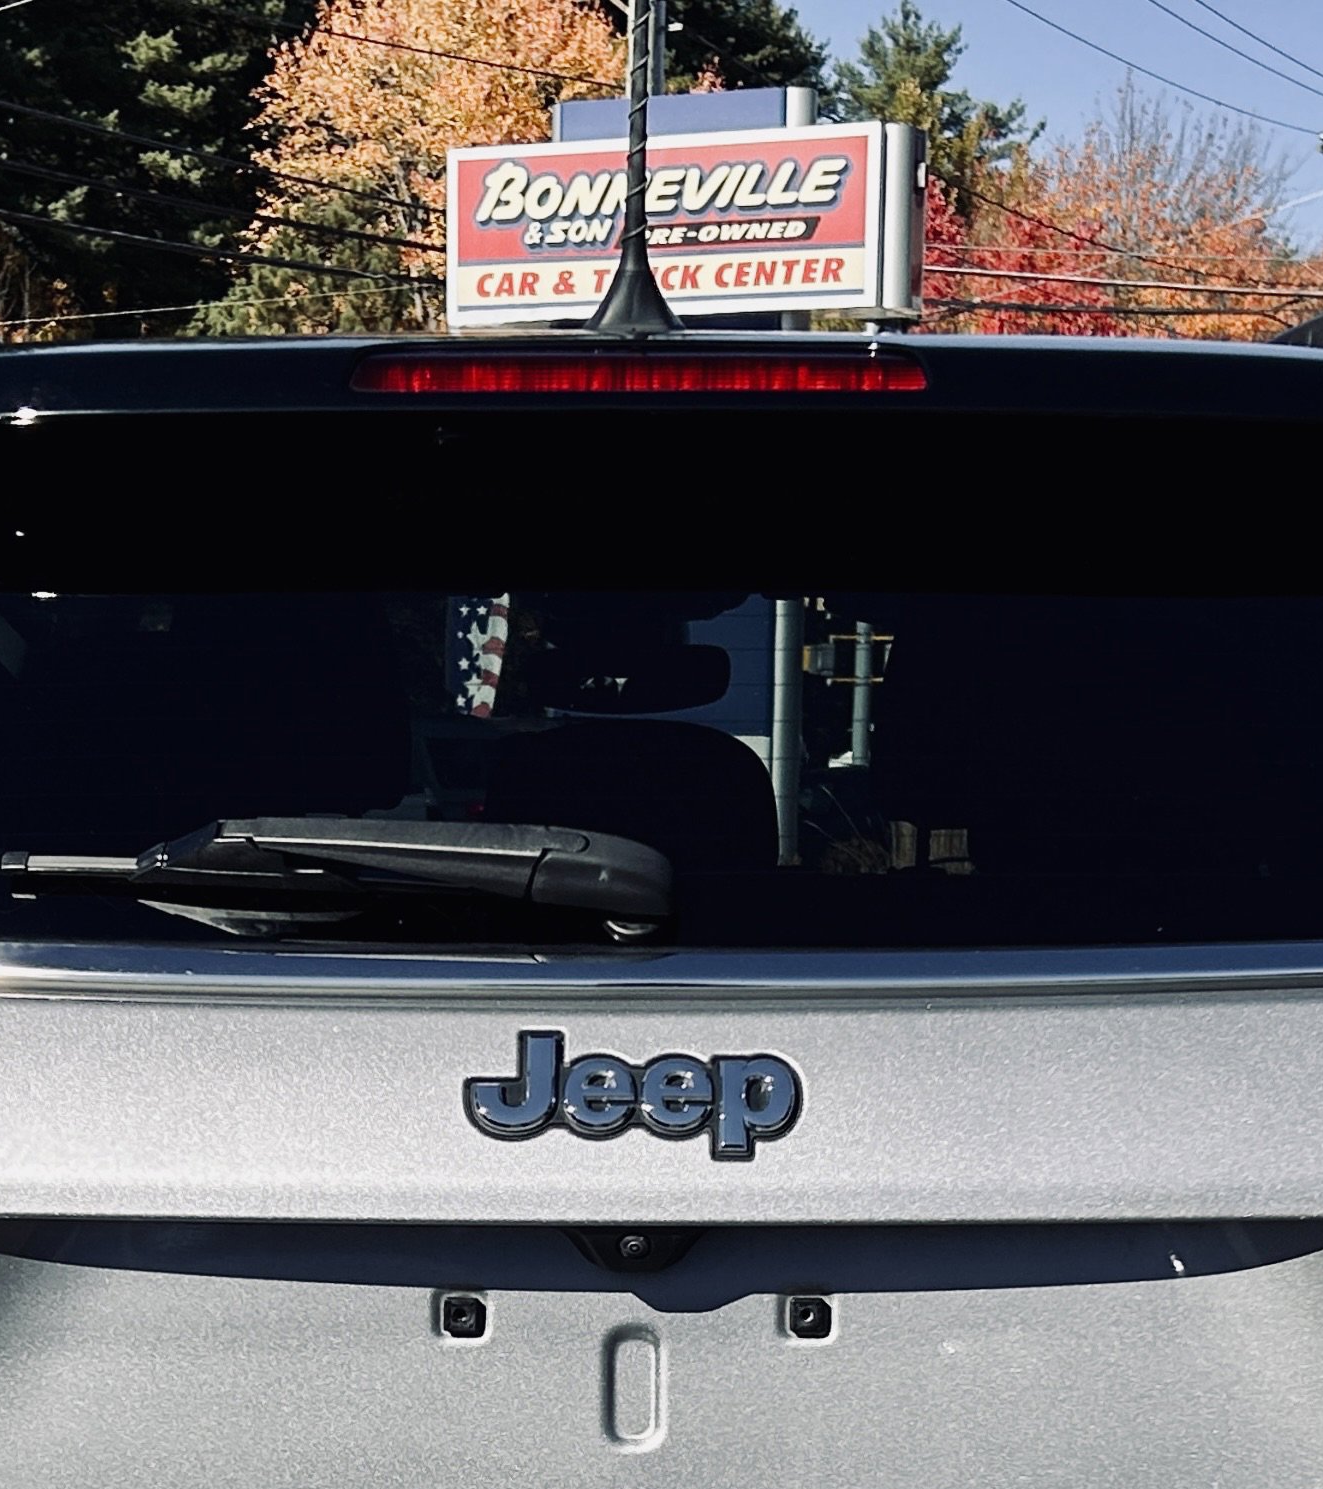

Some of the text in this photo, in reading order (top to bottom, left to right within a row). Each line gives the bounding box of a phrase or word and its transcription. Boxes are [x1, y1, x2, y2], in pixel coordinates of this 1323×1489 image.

[523, 217, 613, 244] & SON
[476, 255, 845, 298] CAR & TCK CENTER
[463, 1029, 804, 1163] Jeep
